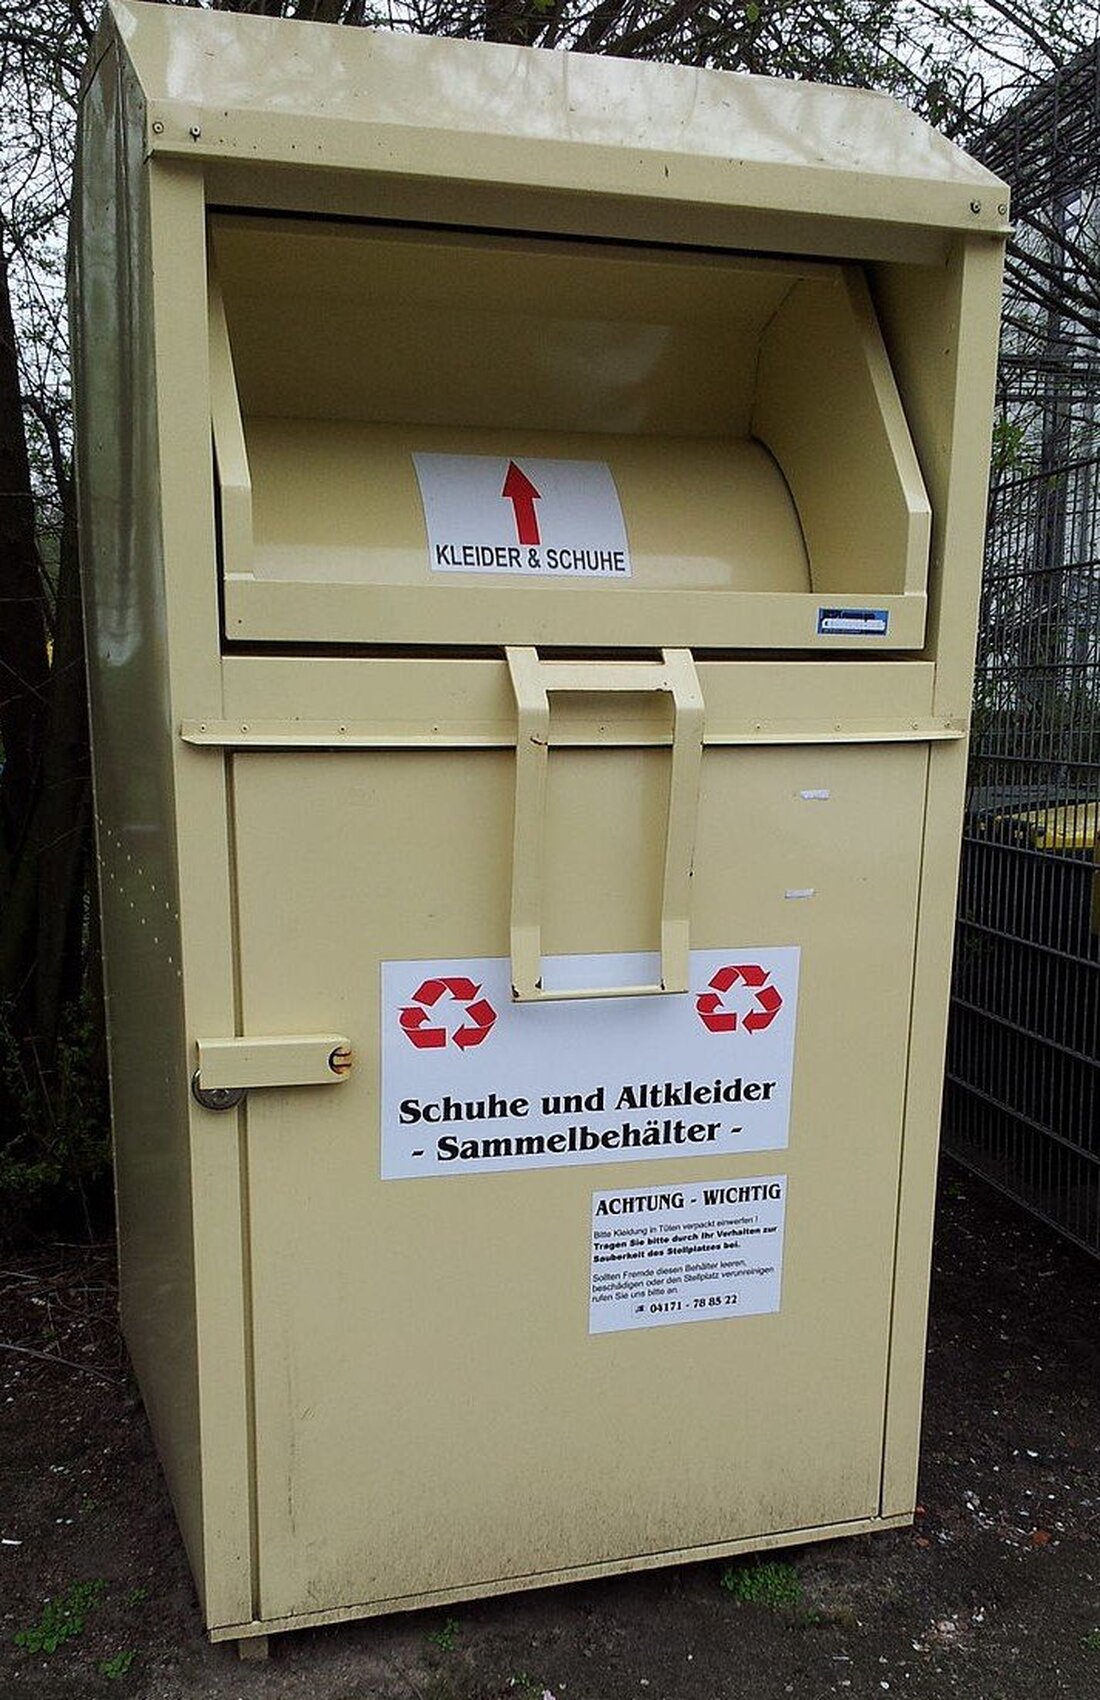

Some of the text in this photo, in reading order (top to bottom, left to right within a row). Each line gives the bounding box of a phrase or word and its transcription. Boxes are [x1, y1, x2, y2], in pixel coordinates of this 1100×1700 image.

[436, 544, 626, 571] KLEIDER & SCHUHE
[399, 1078, 776, 1124] Schuhe und Altkleider
[437, 1119, 721, 1161] Sammelbehälter
[595, 1193, 684, 1216] ACHTUNG
[703, 1183, 781, 1206] WICHTIG
[593, 1226, 778, 1251] Tragen Sie bitte durch Ihr Verhalten zur
[593, 1251, 645, 1263] Sauberkeit
[647, 1249, 664, 1258] des
[667, 1244, 721, 1255] Stellplatzes
[615, 1291, 629, 1300] Sie
[650, 1301, 682, 1313] 04171
[693, 1297, 706, 1308] 78
[708, 1296, 721, 1306] 85
[724, 1294, 737, 1305] 22
